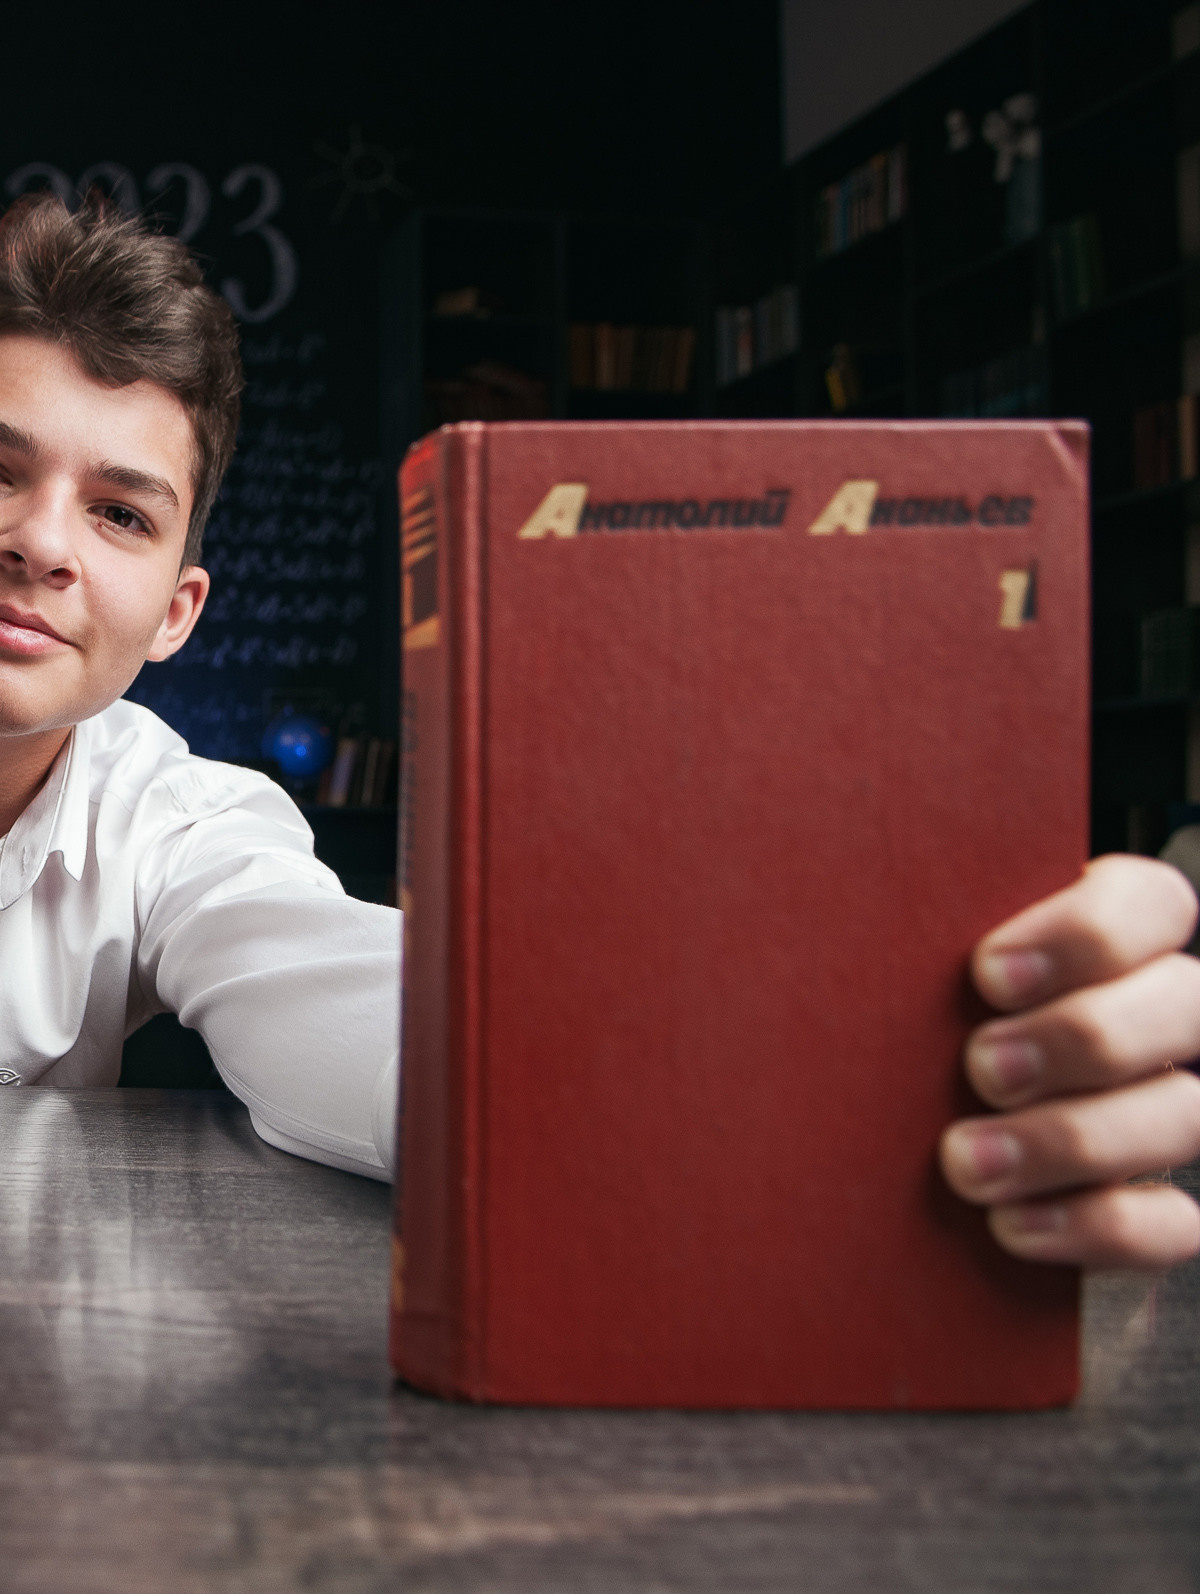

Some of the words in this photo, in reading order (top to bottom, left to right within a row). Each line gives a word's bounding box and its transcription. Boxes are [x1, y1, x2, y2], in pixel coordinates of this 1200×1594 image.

[517, 483, 791, 539] Анатолий
[807, 480, 1035, 535] Ананьев
[998, 560, 1037, 629] 1
